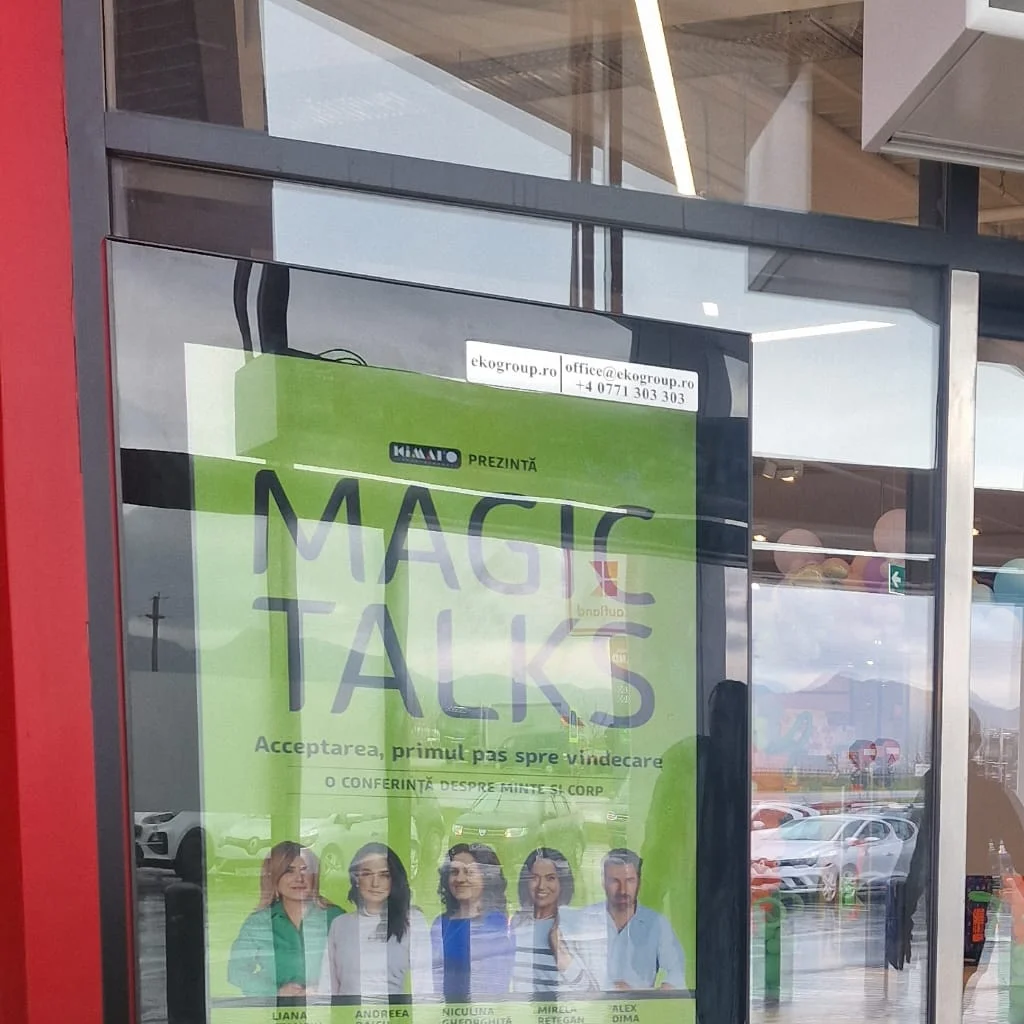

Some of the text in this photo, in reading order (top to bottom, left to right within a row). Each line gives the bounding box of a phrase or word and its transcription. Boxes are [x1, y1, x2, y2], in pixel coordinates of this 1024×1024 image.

[471, 355, 557, 378] ekogroup.ro
[565, 361, 694, 390] office@ekogroup.ro
[576, 381, 685, 404] +4 0771 303 303
[468, 454, 538, 472] PREZINTĂ
[252, 469, 656, 606] MAGIC
[252, 597, 656, 729] TALKS
[255, 736, 664, 769] Acceptarea, primul pas spre vindecare
[325, 776, 336, 788] O
[341, 776, 434, 795] CONFERINȚĂ
[440, 781, 495, 793] DESPRE
[501, 783, 545, 795] MINTE
[568, 785, 603, 797] CORP
[355, 1010, 410, 1019] ANDREEA
[612, 1004, 637, 1013] ALEX
[612, 1014, 640, 1023] DIMA
